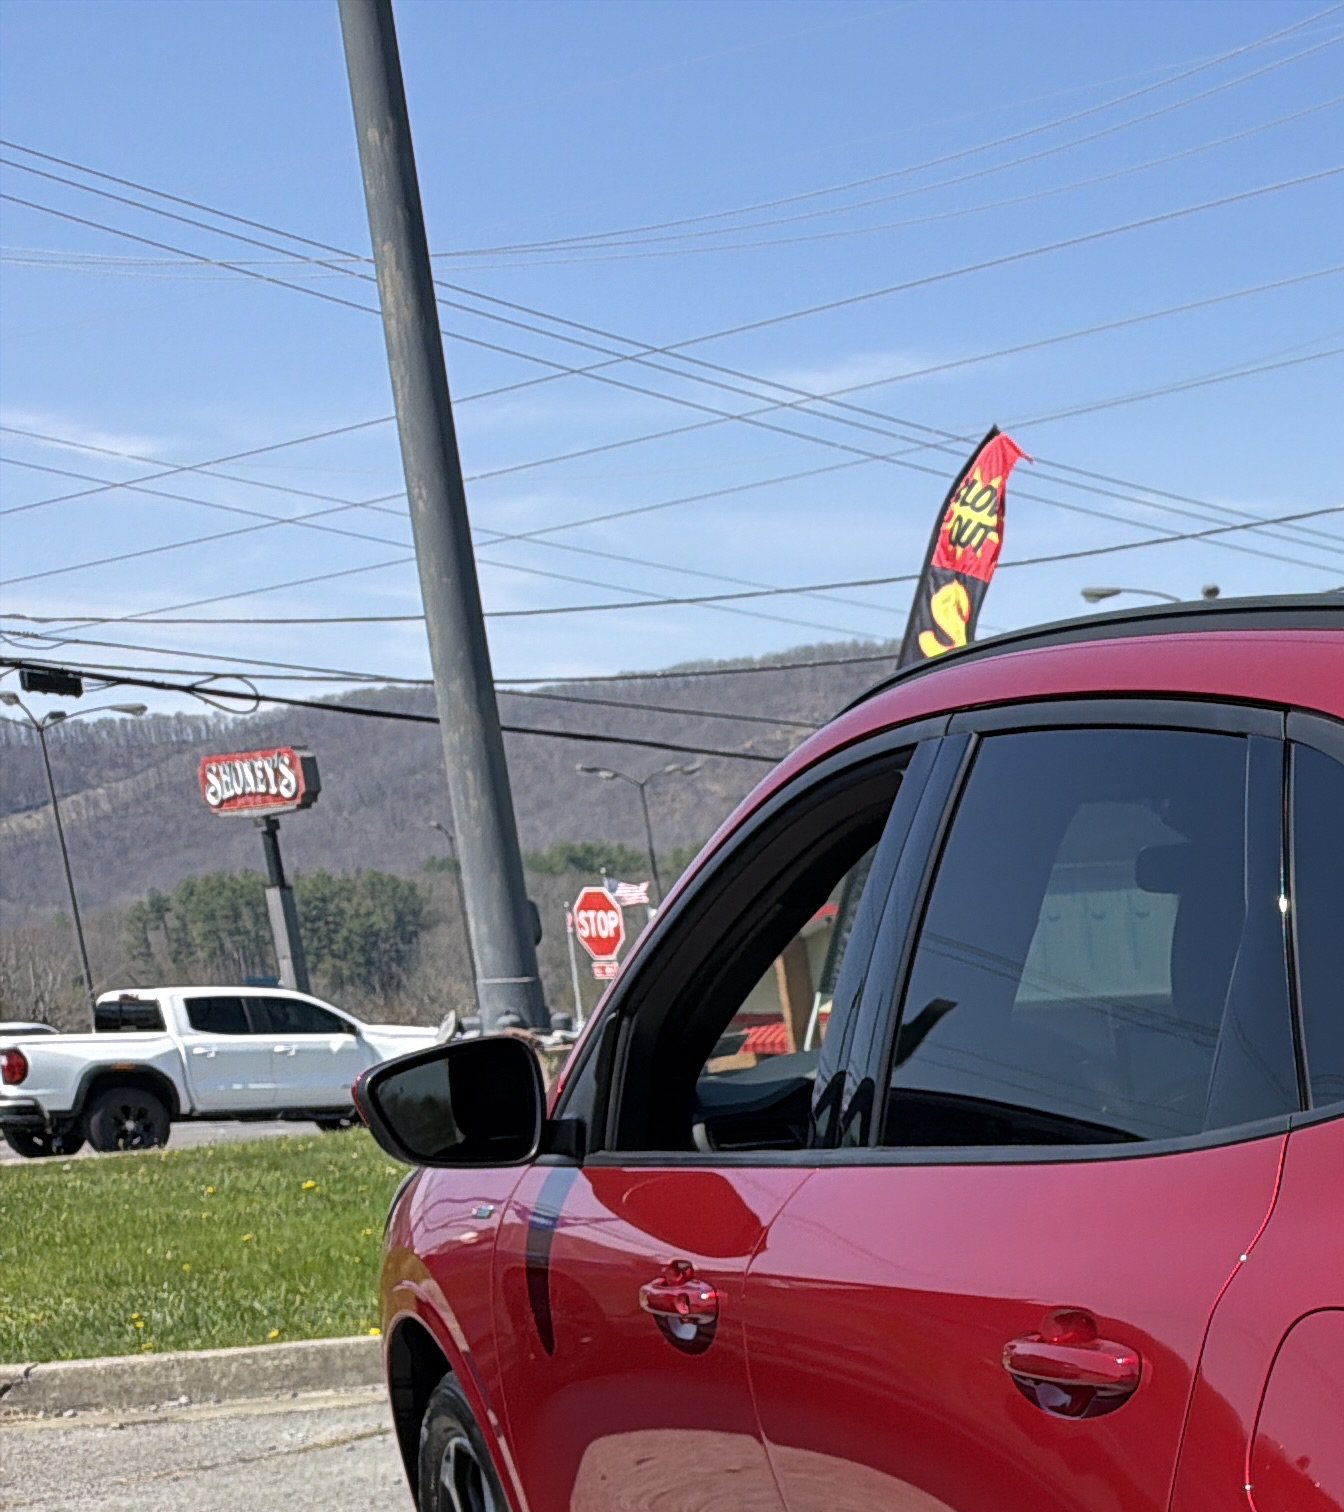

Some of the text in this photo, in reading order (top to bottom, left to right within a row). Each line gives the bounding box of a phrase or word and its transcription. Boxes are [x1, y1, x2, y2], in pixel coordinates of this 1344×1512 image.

[949, 514, 998, 553] OUT
[206, 752, 297, 806] SHONEY'S
[578, 909, 619, 939] STOP
